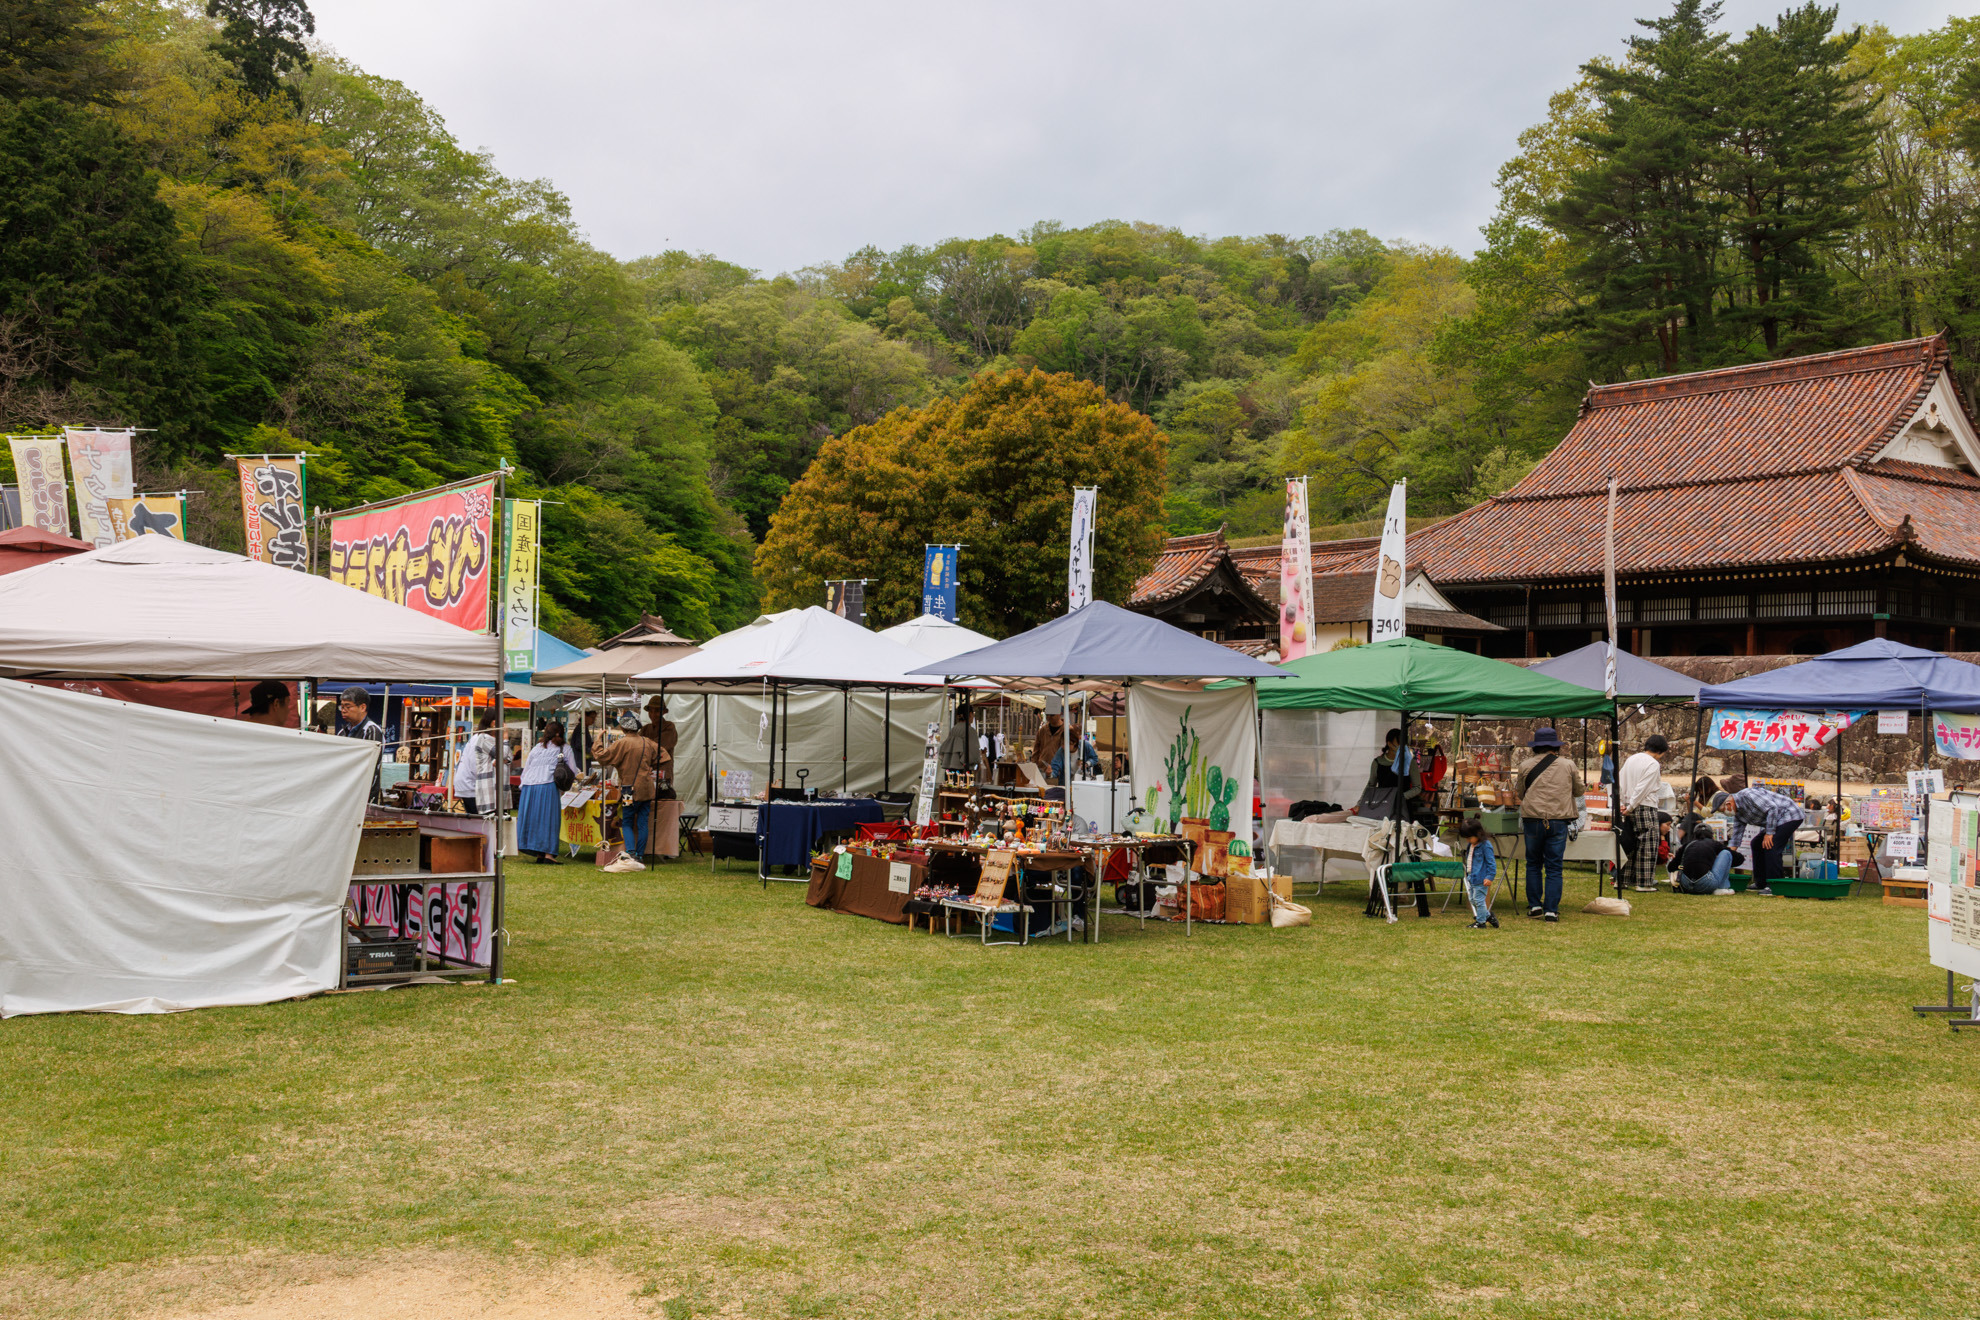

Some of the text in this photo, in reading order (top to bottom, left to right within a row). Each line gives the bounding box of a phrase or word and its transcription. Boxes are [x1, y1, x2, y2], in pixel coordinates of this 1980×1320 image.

[1719, 719, 1846, 747] めだかすく
[718, 814, 730, 826] 天
[568, 822, 593, 843] 専門店
[368, 951, 396, 959] TRIAL
